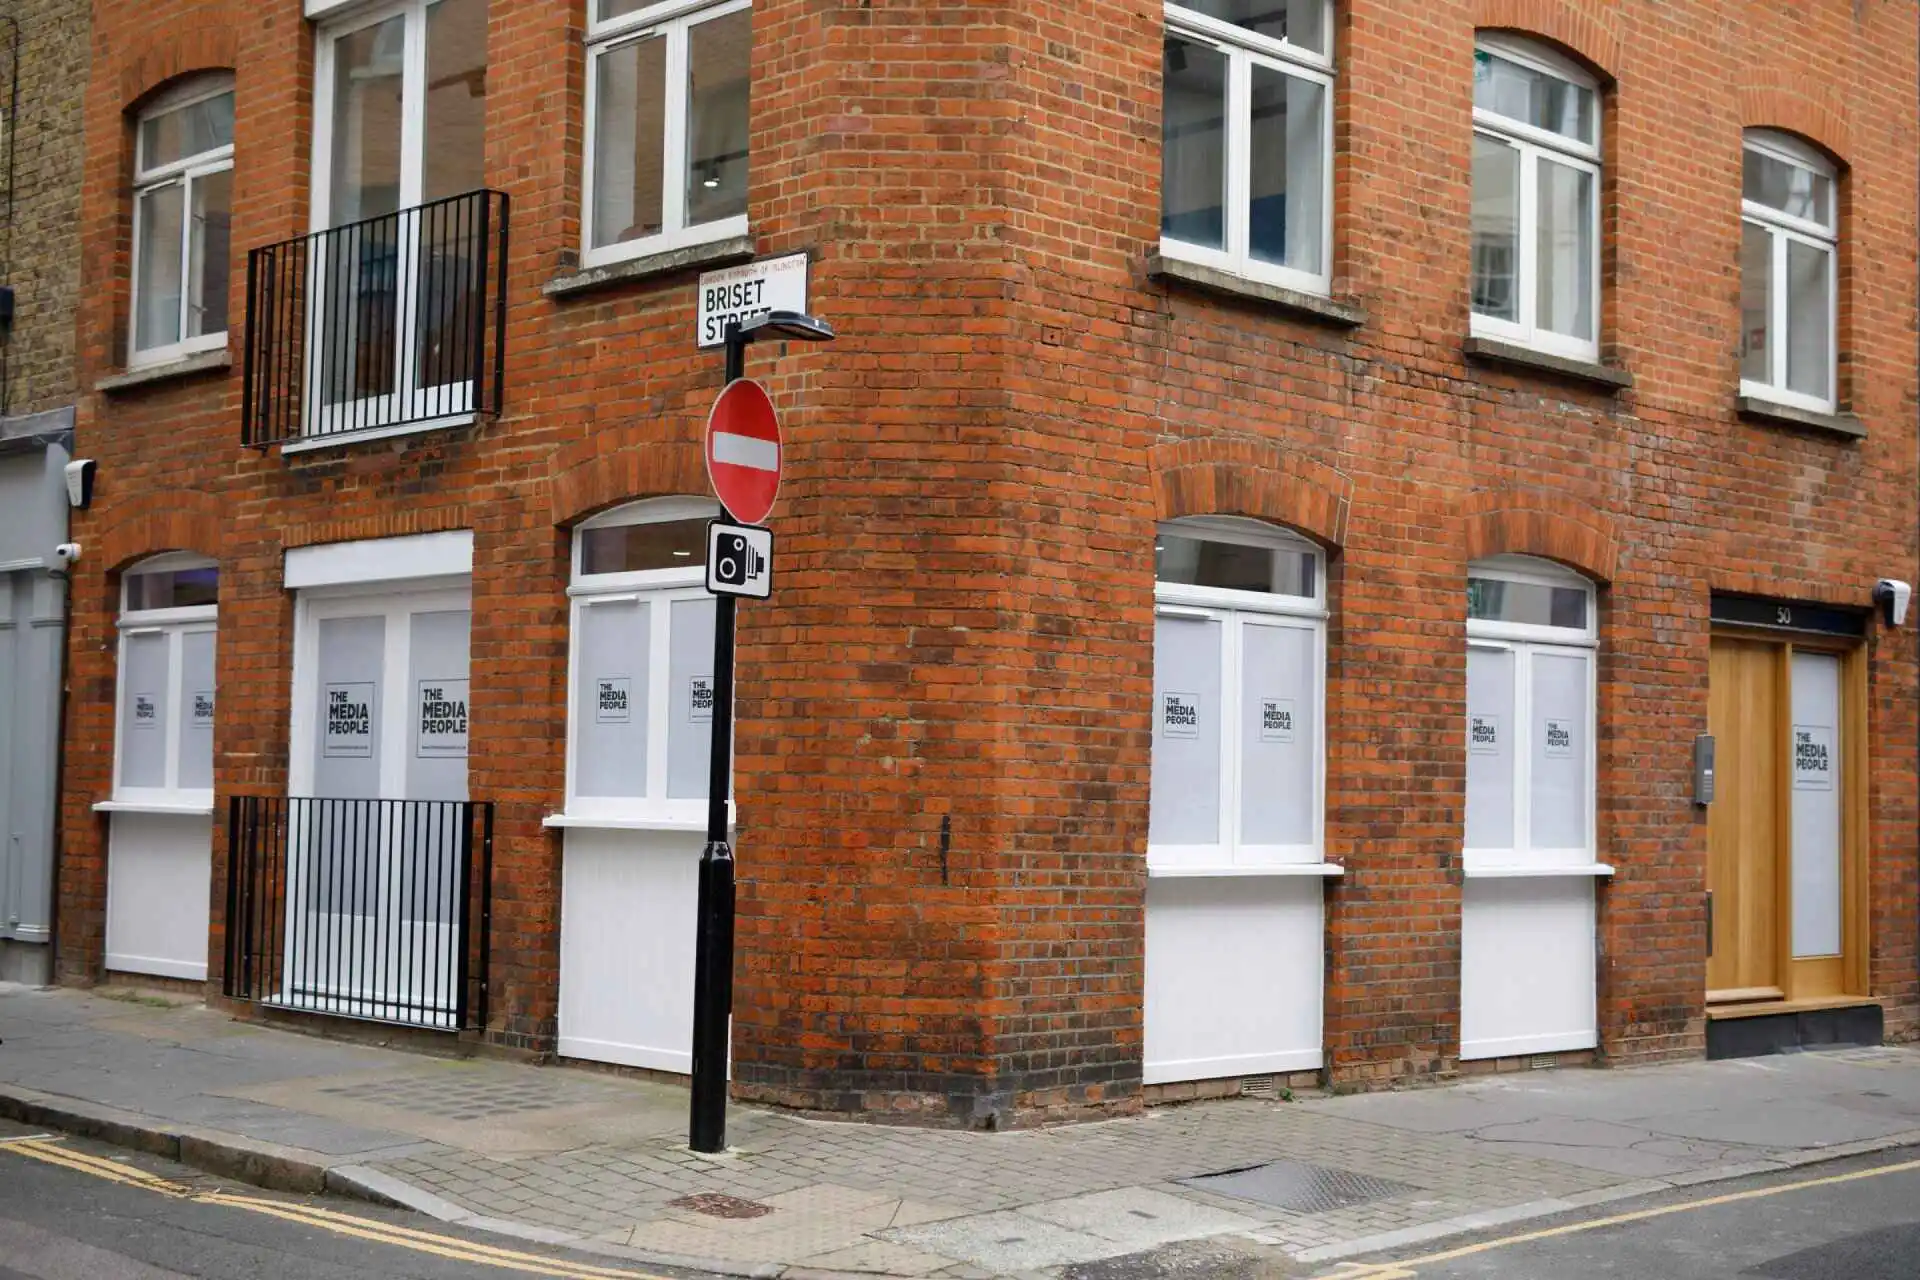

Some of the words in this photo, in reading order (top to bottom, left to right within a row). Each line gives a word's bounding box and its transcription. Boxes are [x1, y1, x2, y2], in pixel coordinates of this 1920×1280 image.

[706, 279, 765, 312] BRISET
[1777, 606, 1791, 624] 50
[330, 691, 348, 702] THE
[424, 688, 443, 700] THE
[600, 691, 626, 700] MEDIA
[692, 689, 712, 699] MED
[600, 701, 627, 709] PEOPLE
[692, 700, 713, 708] PEOP
[1166, 697, 1180, 705] THE
[329, 704, 368, 719] MEDIA
[422, 702, 466, 718] MEDIA
[1166, 705, 1196, 716] MEDIA
[1166, 716, 1196, 725] PEOPLE
[1264, 711, 1292, 721] MEDIA
[329, 721, 368, 734] PEOPLE
[422, 720, 466, 734] PEOPLE
[1264, 721, 1292, 729] PEOPLE
[1472, 726, 1495, 735] MEDIA
[1547, 730, 1569, 739] MEDIA
[1472, 735, 1496, 743] PEOPLE
[1796, 732, 1811, 742] THE
[1796, 744, 1828, 758] MEDIA
[1796, 758, 1828, 771] PEOPLE
